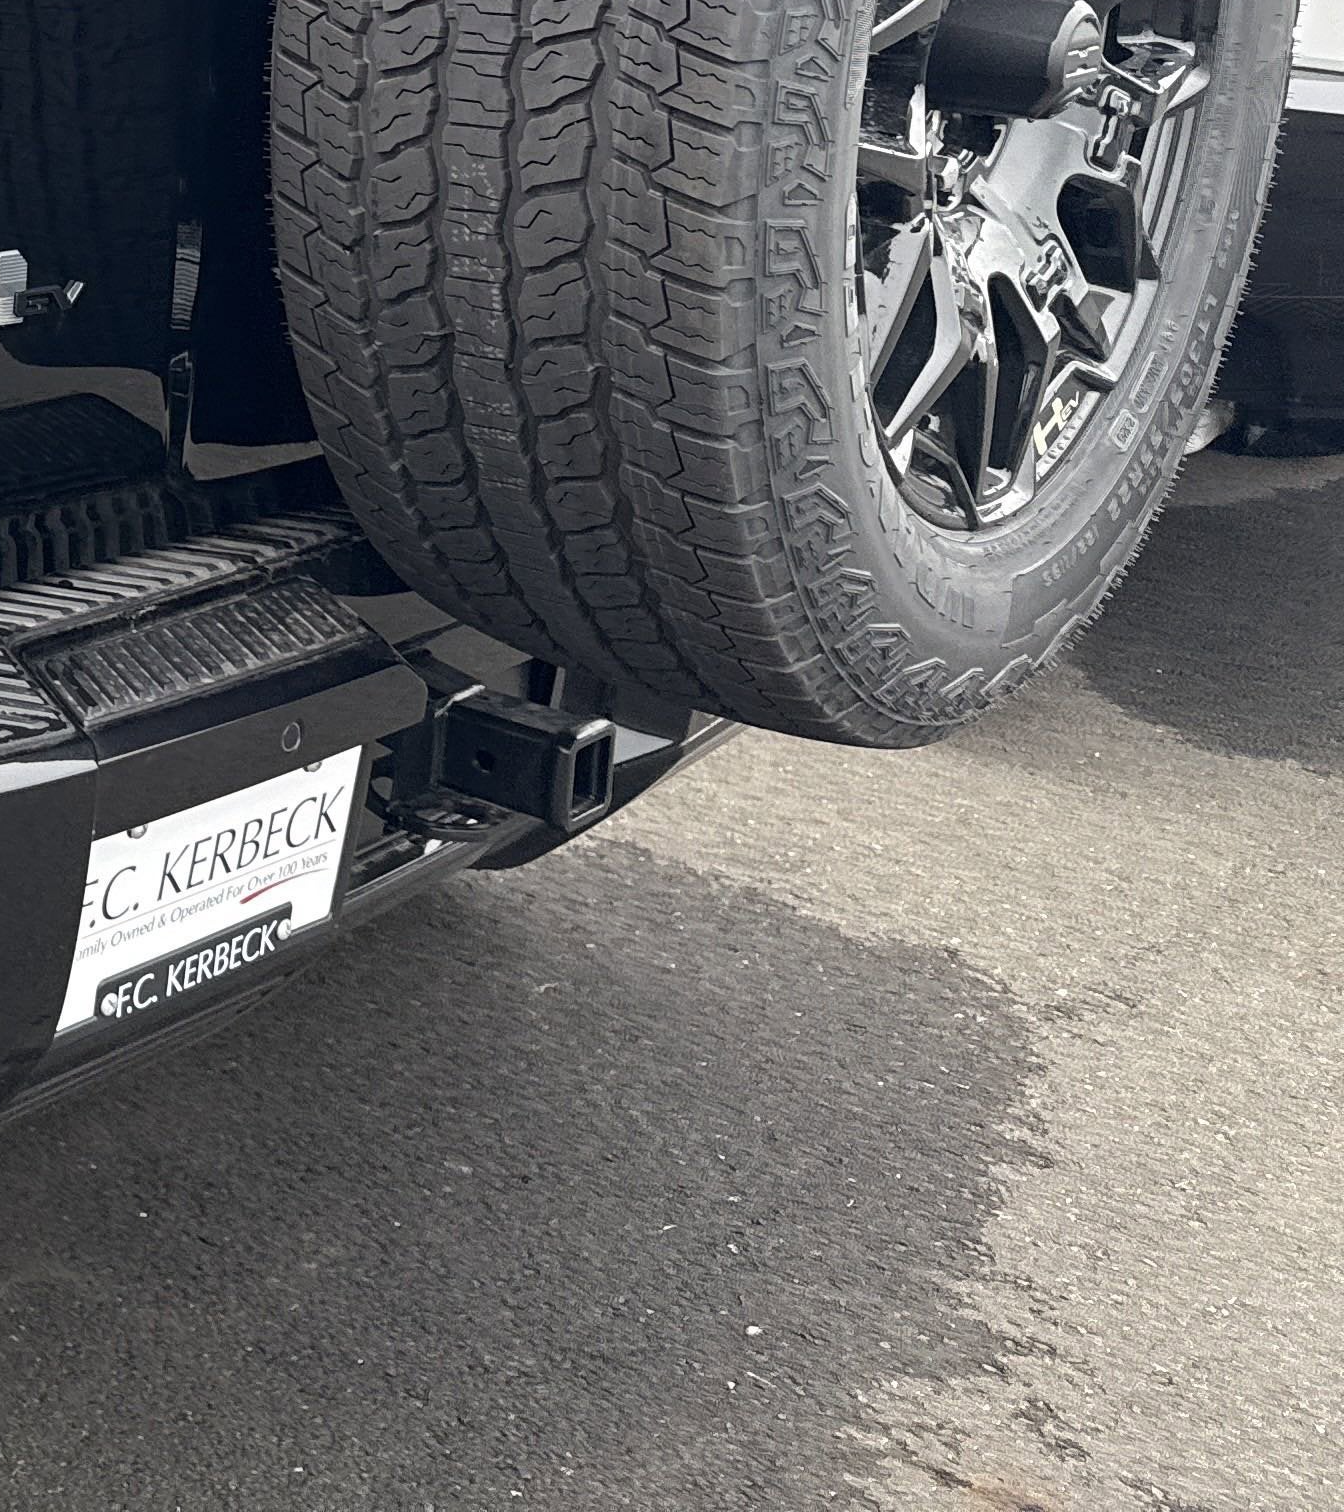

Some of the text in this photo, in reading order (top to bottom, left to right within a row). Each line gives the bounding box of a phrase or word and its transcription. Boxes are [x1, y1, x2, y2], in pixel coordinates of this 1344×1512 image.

[157, 786, 344, 901] KERBECK
[111, 916, 155, 946] Owned
[158, 913, 167, 927] &
[171, 891, 224, 923] Operated
[226, 884, 245, 901] For
[247, 872, 276, 892] Over
[278, 861, 298, 879] 100
[302, 852, 328, 871] Years
[116, 919, 278, 1018] F.C. KERBECK
